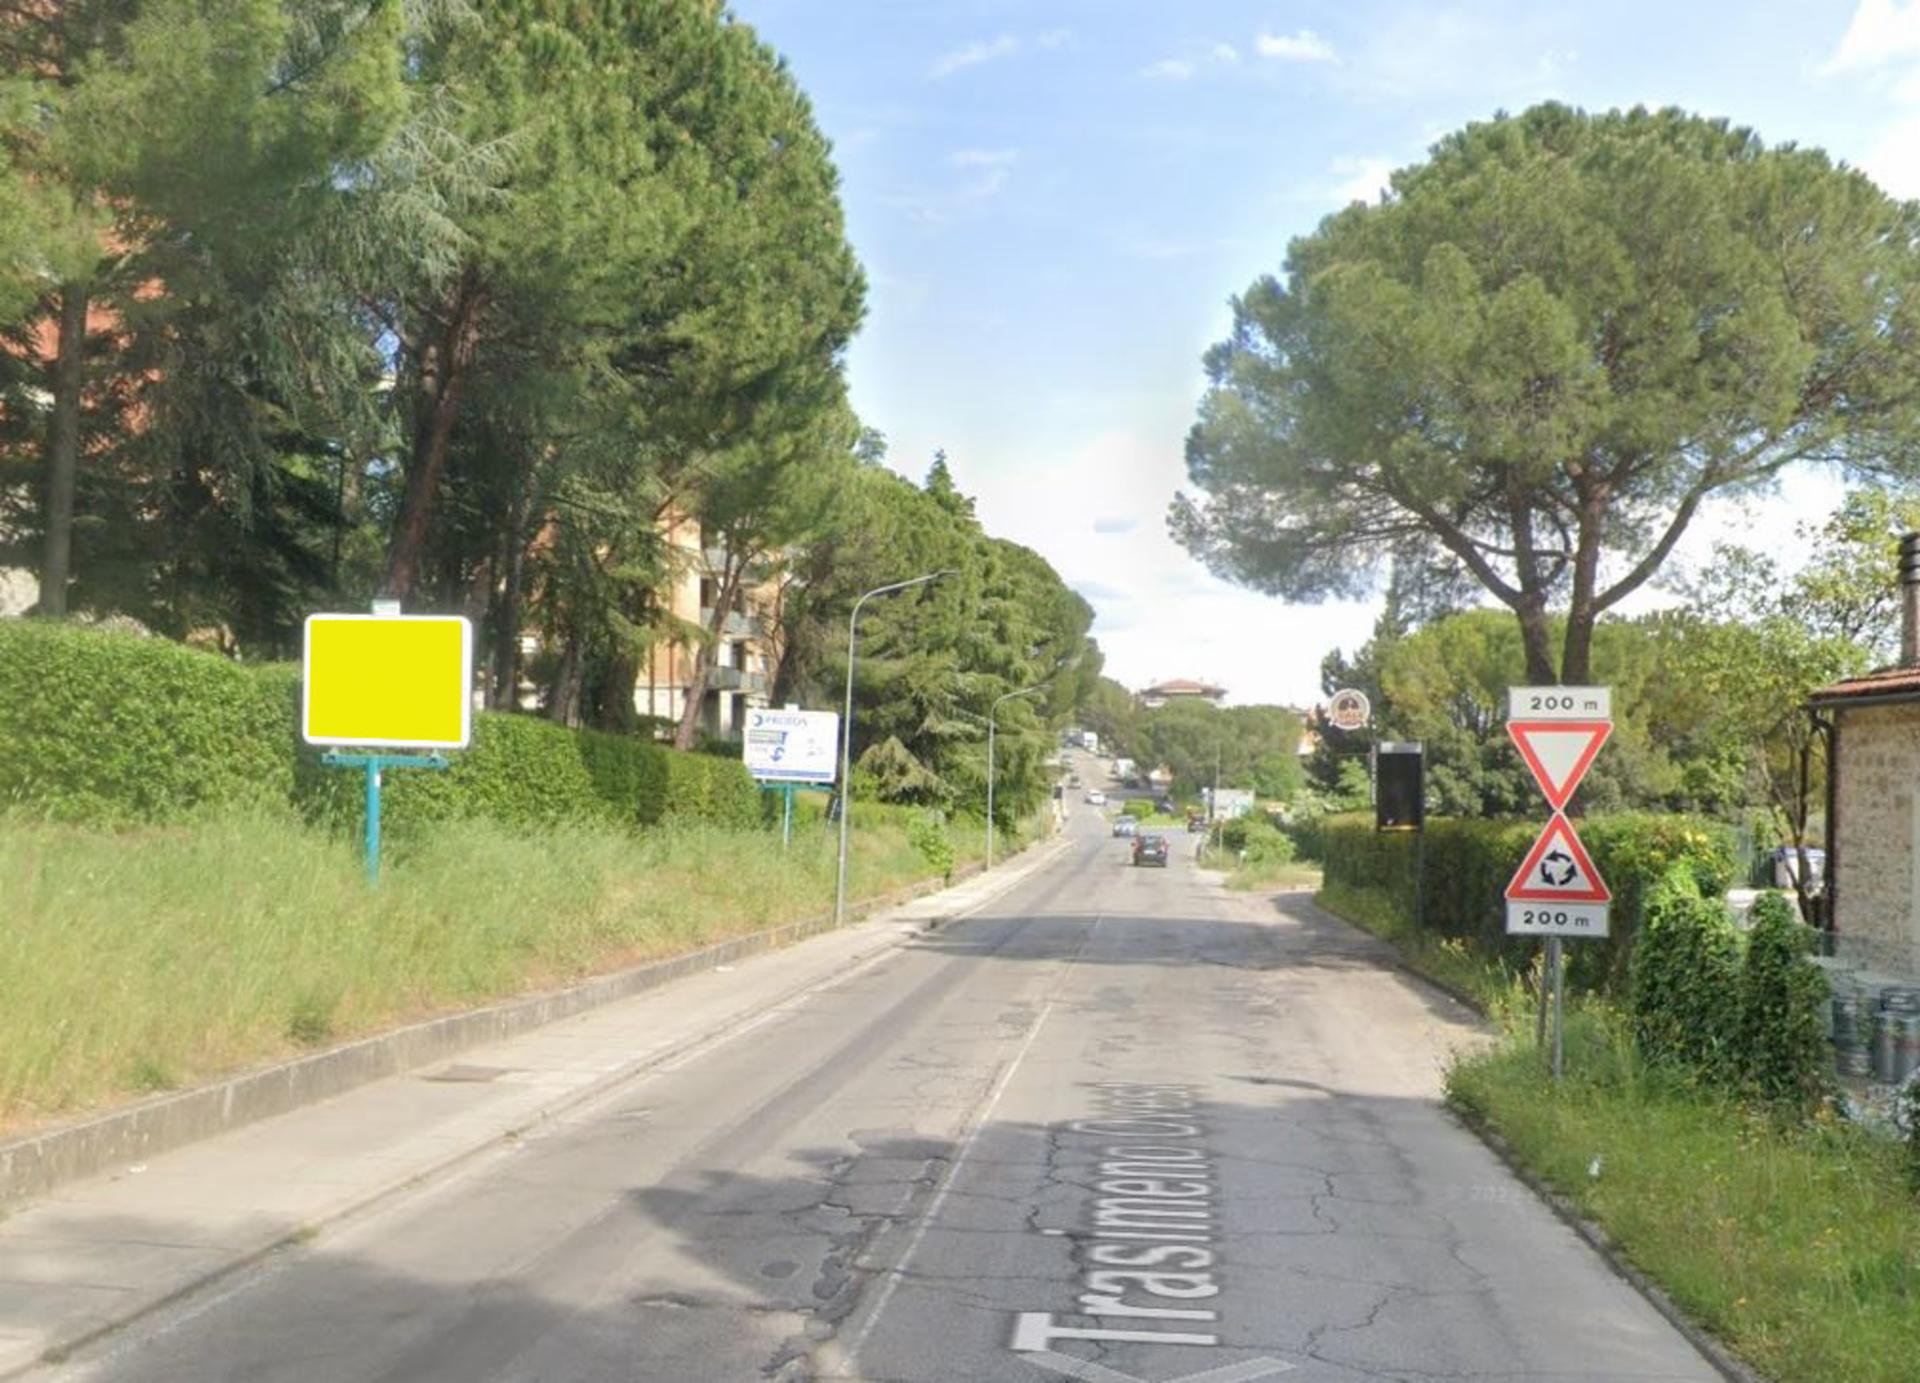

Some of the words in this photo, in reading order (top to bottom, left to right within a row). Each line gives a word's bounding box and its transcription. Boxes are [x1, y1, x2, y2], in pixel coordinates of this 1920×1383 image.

[1530, 696, 1574, 711] 200
[1584, 700, 1598, 710] m
[1523, 910, 1568, 925] 200
[1574, 914, 1590, 926] m
